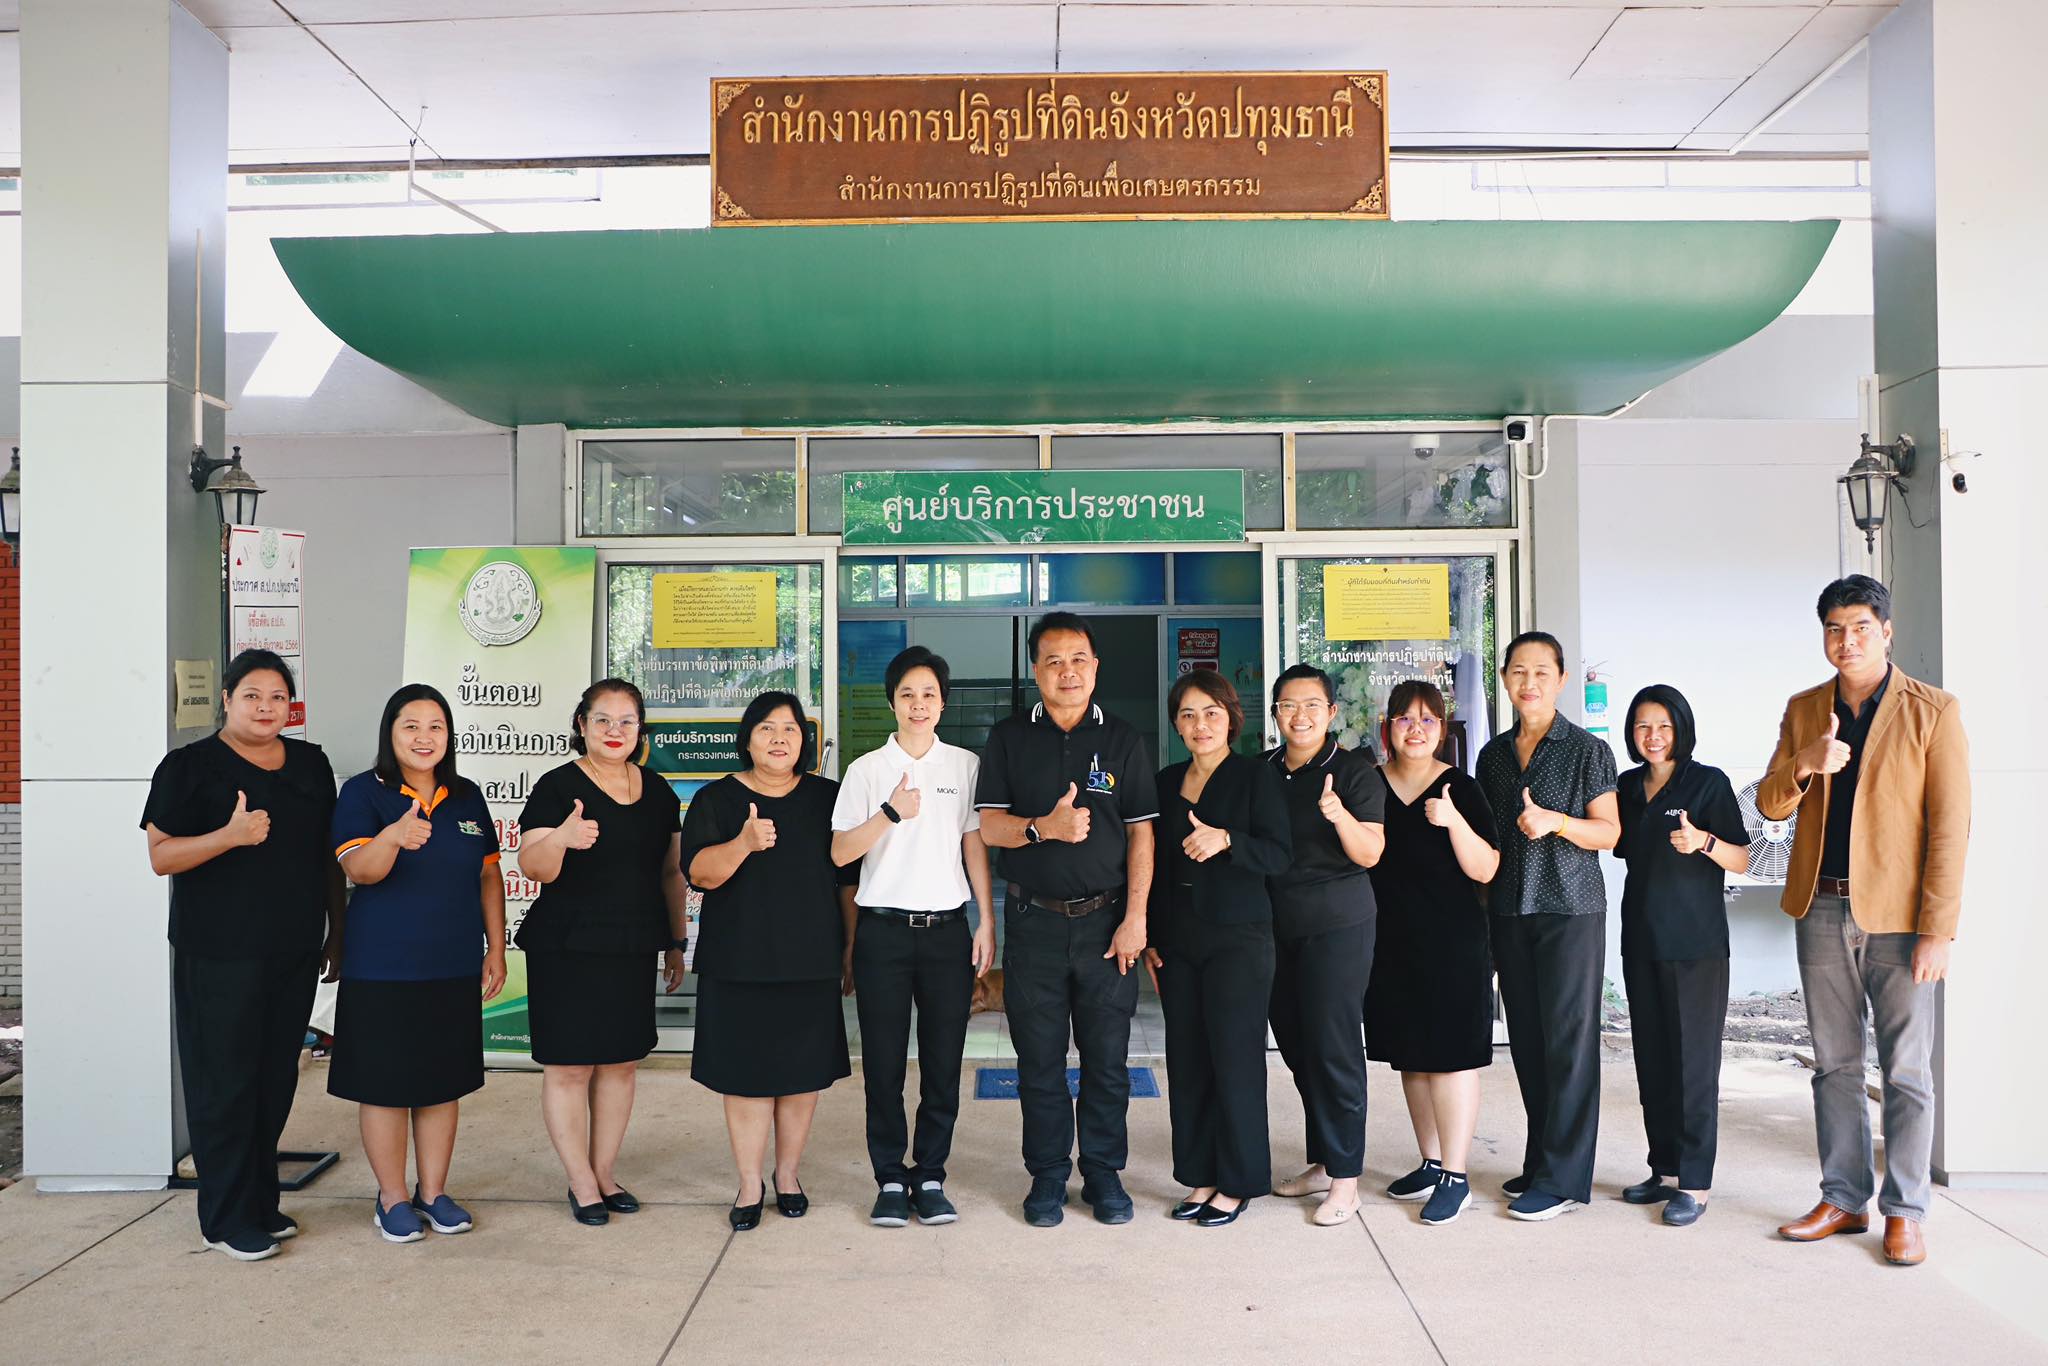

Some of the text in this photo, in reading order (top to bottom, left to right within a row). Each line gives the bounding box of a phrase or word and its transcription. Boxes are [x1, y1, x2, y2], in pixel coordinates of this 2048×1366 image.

[741, 79, 1355, 157] สำนักงานการปฏิรูปที่ดินจังหวัดปทุมธานี
[838, 161, 1262, 209] สำนักงานการปฏิรูปที่ดินเพื่อเกษตรกรรม
[883, 483, 1205, 533] ศูนย์บริการประชาชน
[457, 664, 538, 702] ขั้นตอน
